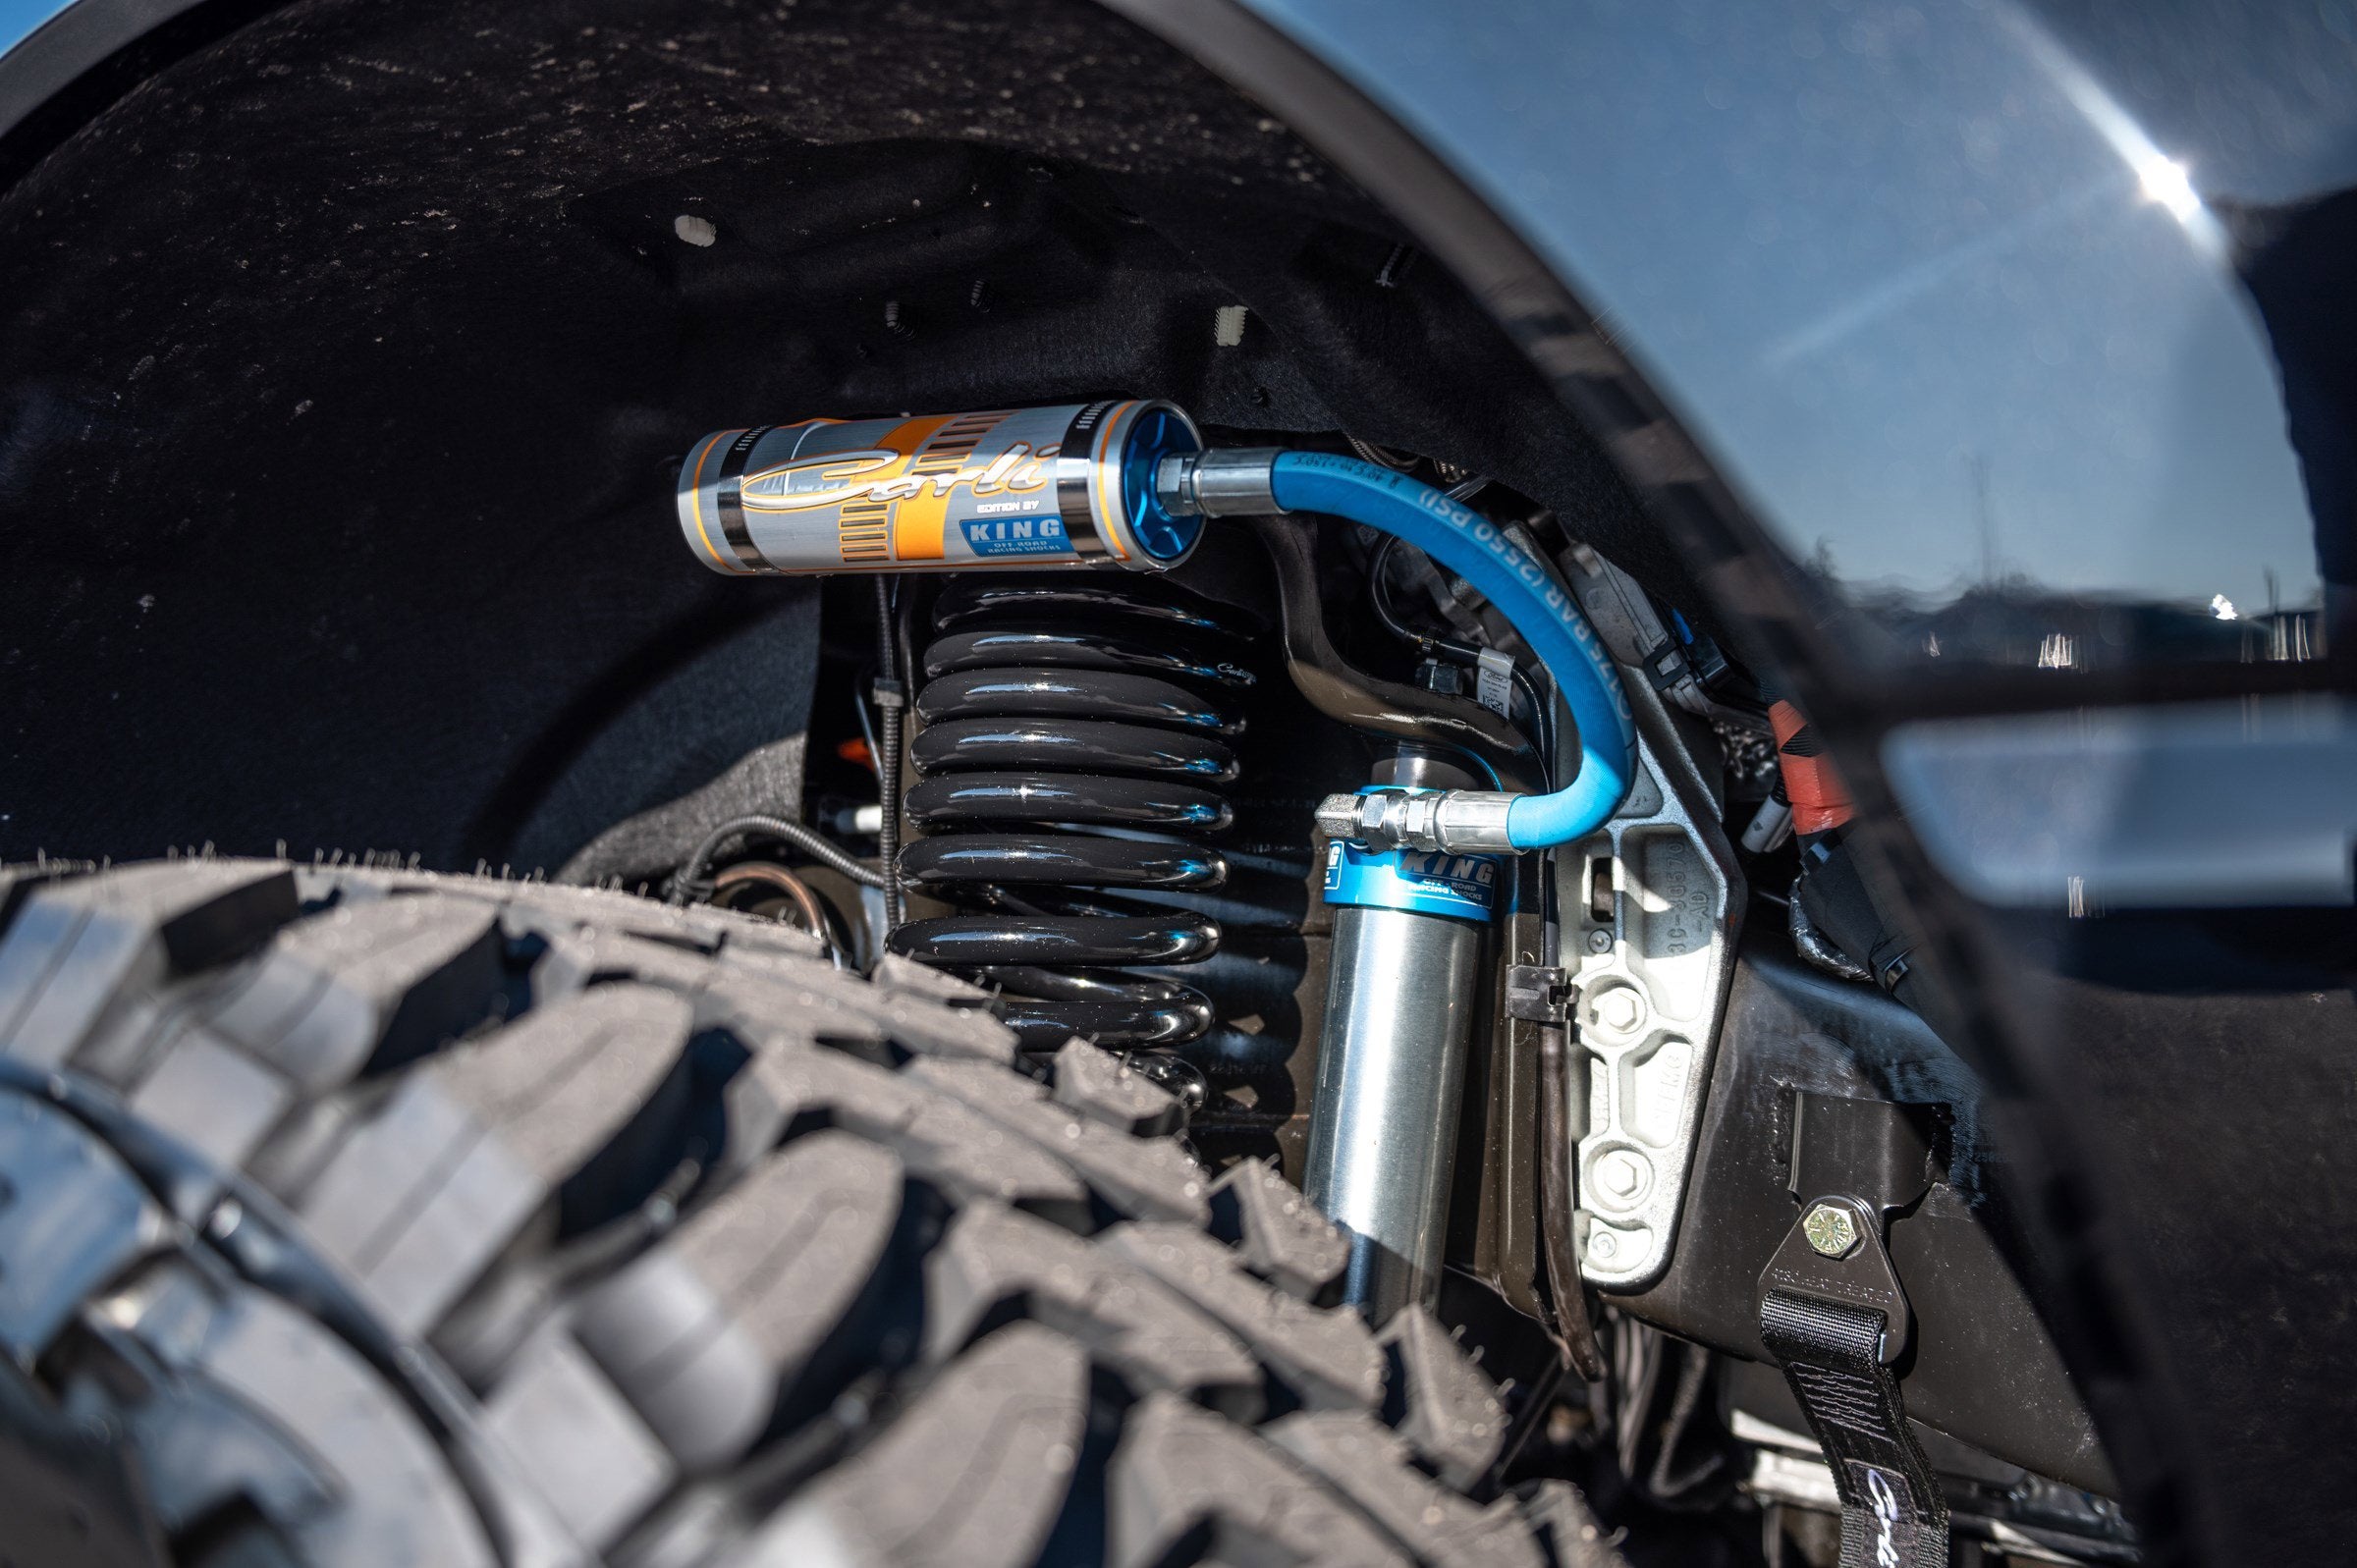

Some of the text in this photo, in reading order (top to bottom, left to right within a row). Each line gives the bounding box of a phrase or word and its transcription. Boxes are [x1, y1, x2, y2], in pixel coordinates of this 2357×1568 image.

[741, 442, 1062, 510] Carli
[976, 500, 1040, 514] EDITION BY
[969, 518, 1061, 542] KING
[1419, 489, 1621, 693] 175 BAR (2550 PSI)
[1400, 851, 1496, 884] KING
